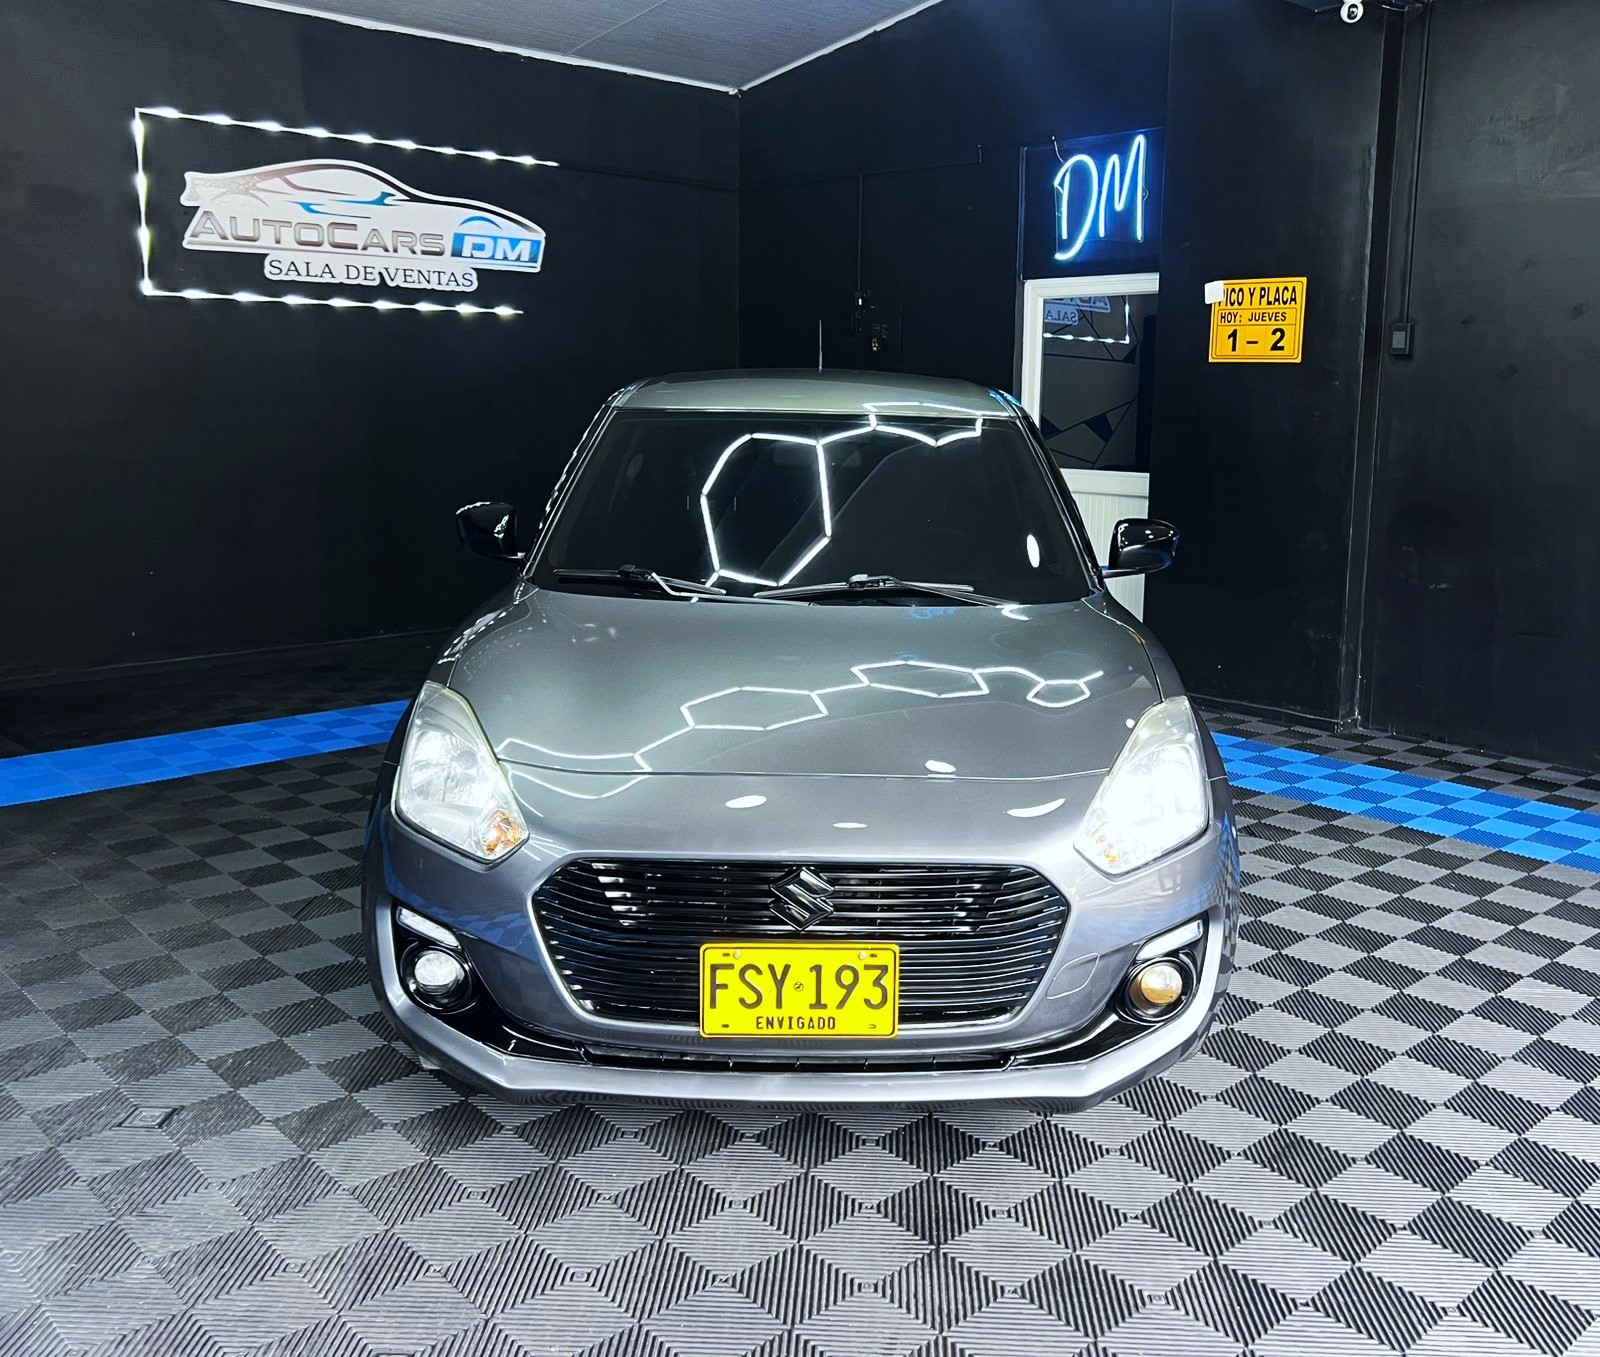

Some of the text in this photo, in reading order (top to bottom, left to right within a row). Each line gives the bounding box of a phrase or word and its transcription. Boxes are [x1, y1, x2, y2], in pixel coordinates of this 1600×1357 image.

[1053, 134, 1146, 260] DM
[461, 235, 531, 262] DM
[268, 259, 474, 288] SALA DE VENTAS
[1248, 287, 1256, 307] Y
[1258, 285, 1298, 306] PLACA
[1220, 311, 1288, 324] HOY: JUEVES
[1227, 328, 1239, 352] 1
[1269, 327, 1286, 352] 2
[708, 962, 889, 1010] FSY 193
[755, 1015, 837, 1030] ENVIGADO
